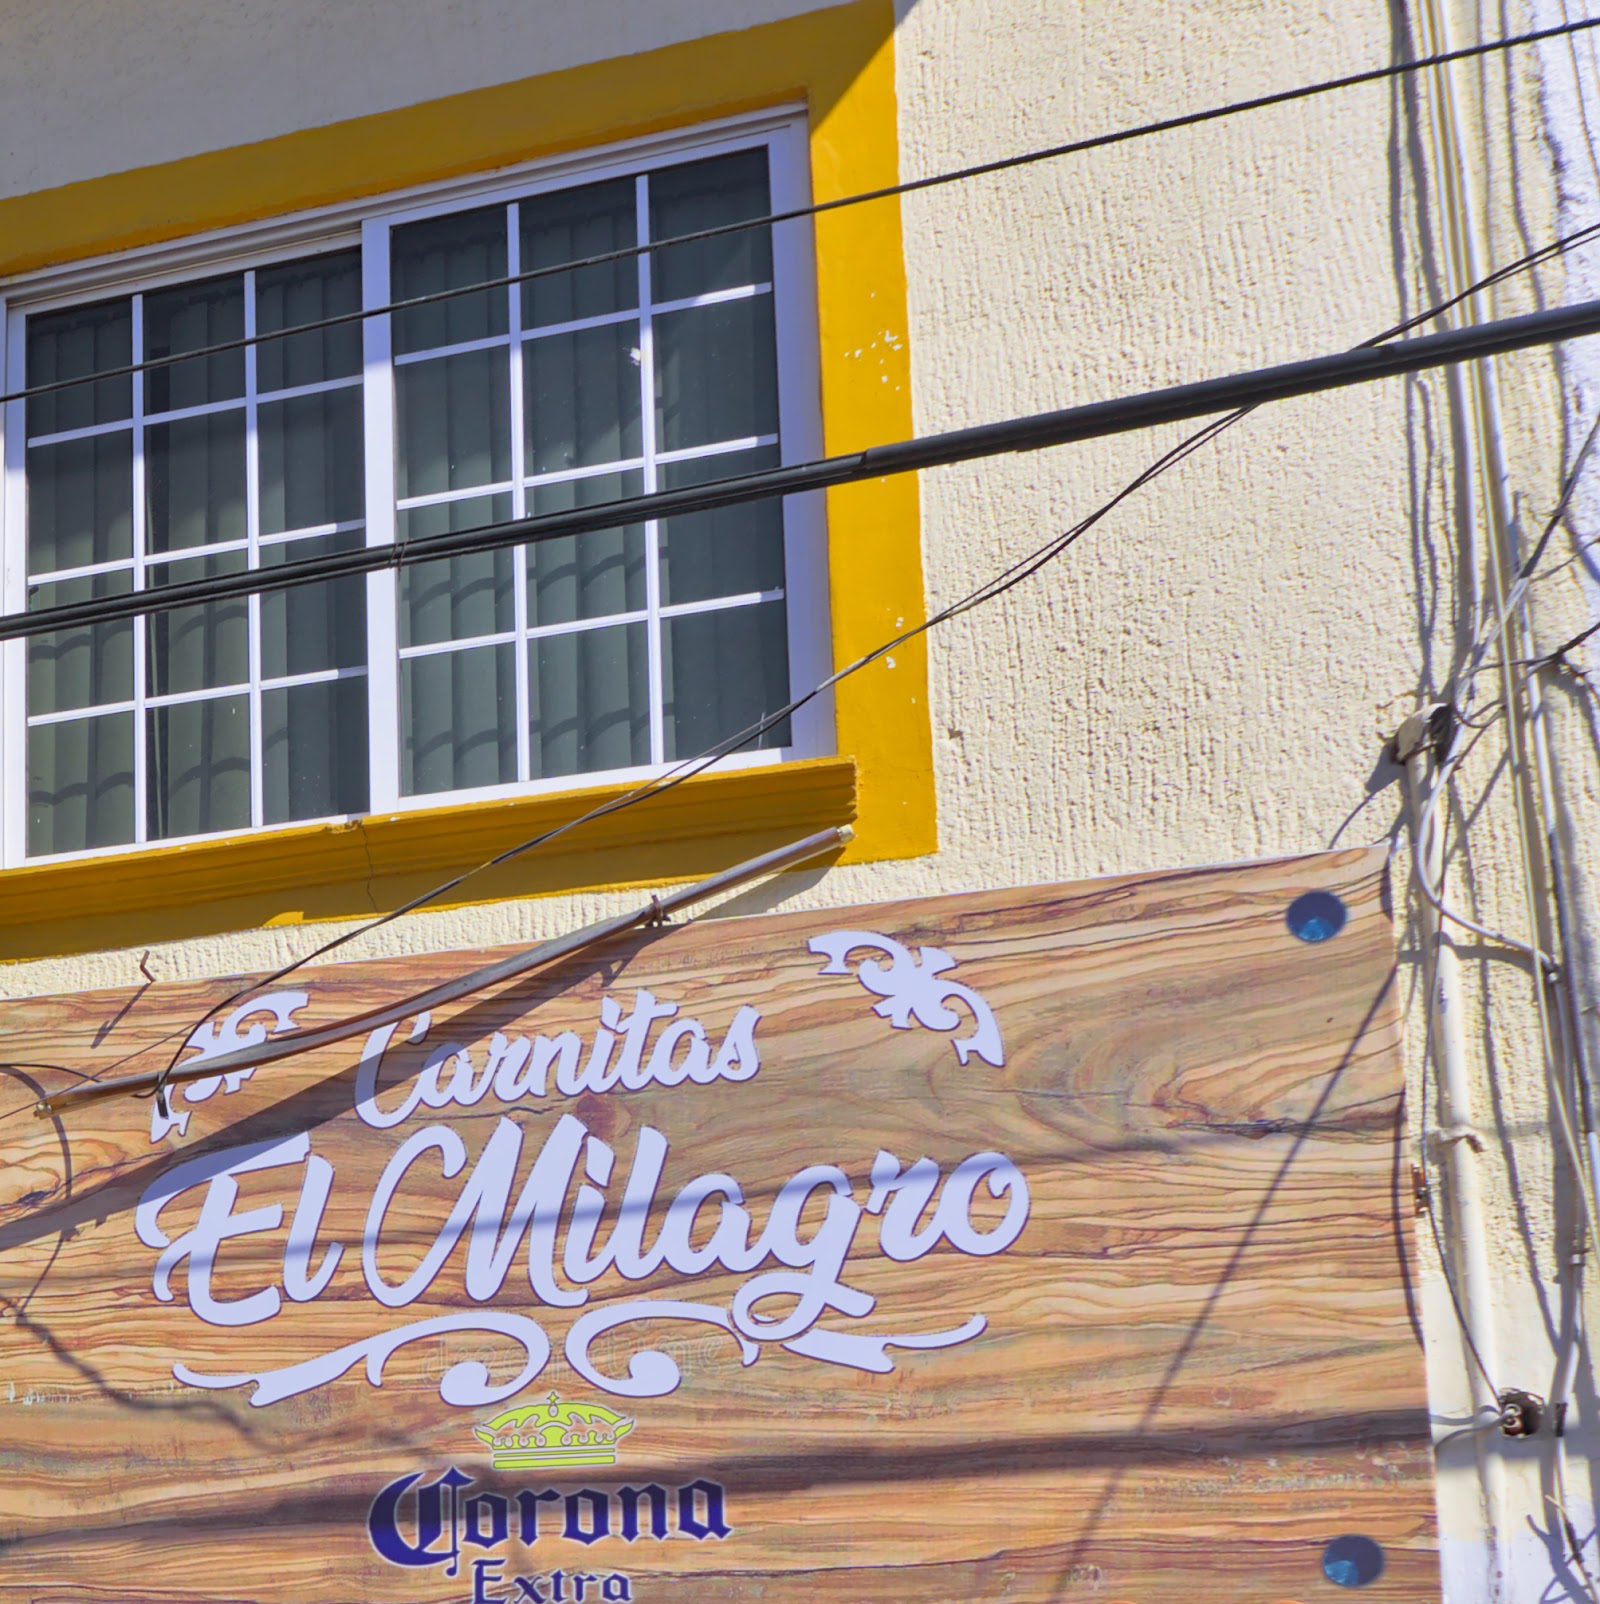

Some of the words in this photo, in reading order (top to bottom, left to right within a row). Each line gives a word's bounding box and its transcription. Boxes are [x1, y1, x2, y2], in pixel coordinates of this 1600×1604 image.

[352, 988, 760, 1132] Carnitas
[134, 1130, 343, 1326] El
[359, 1115, 1032, 1341] Milagro
[368, 1466, 734, 1577] Corona
